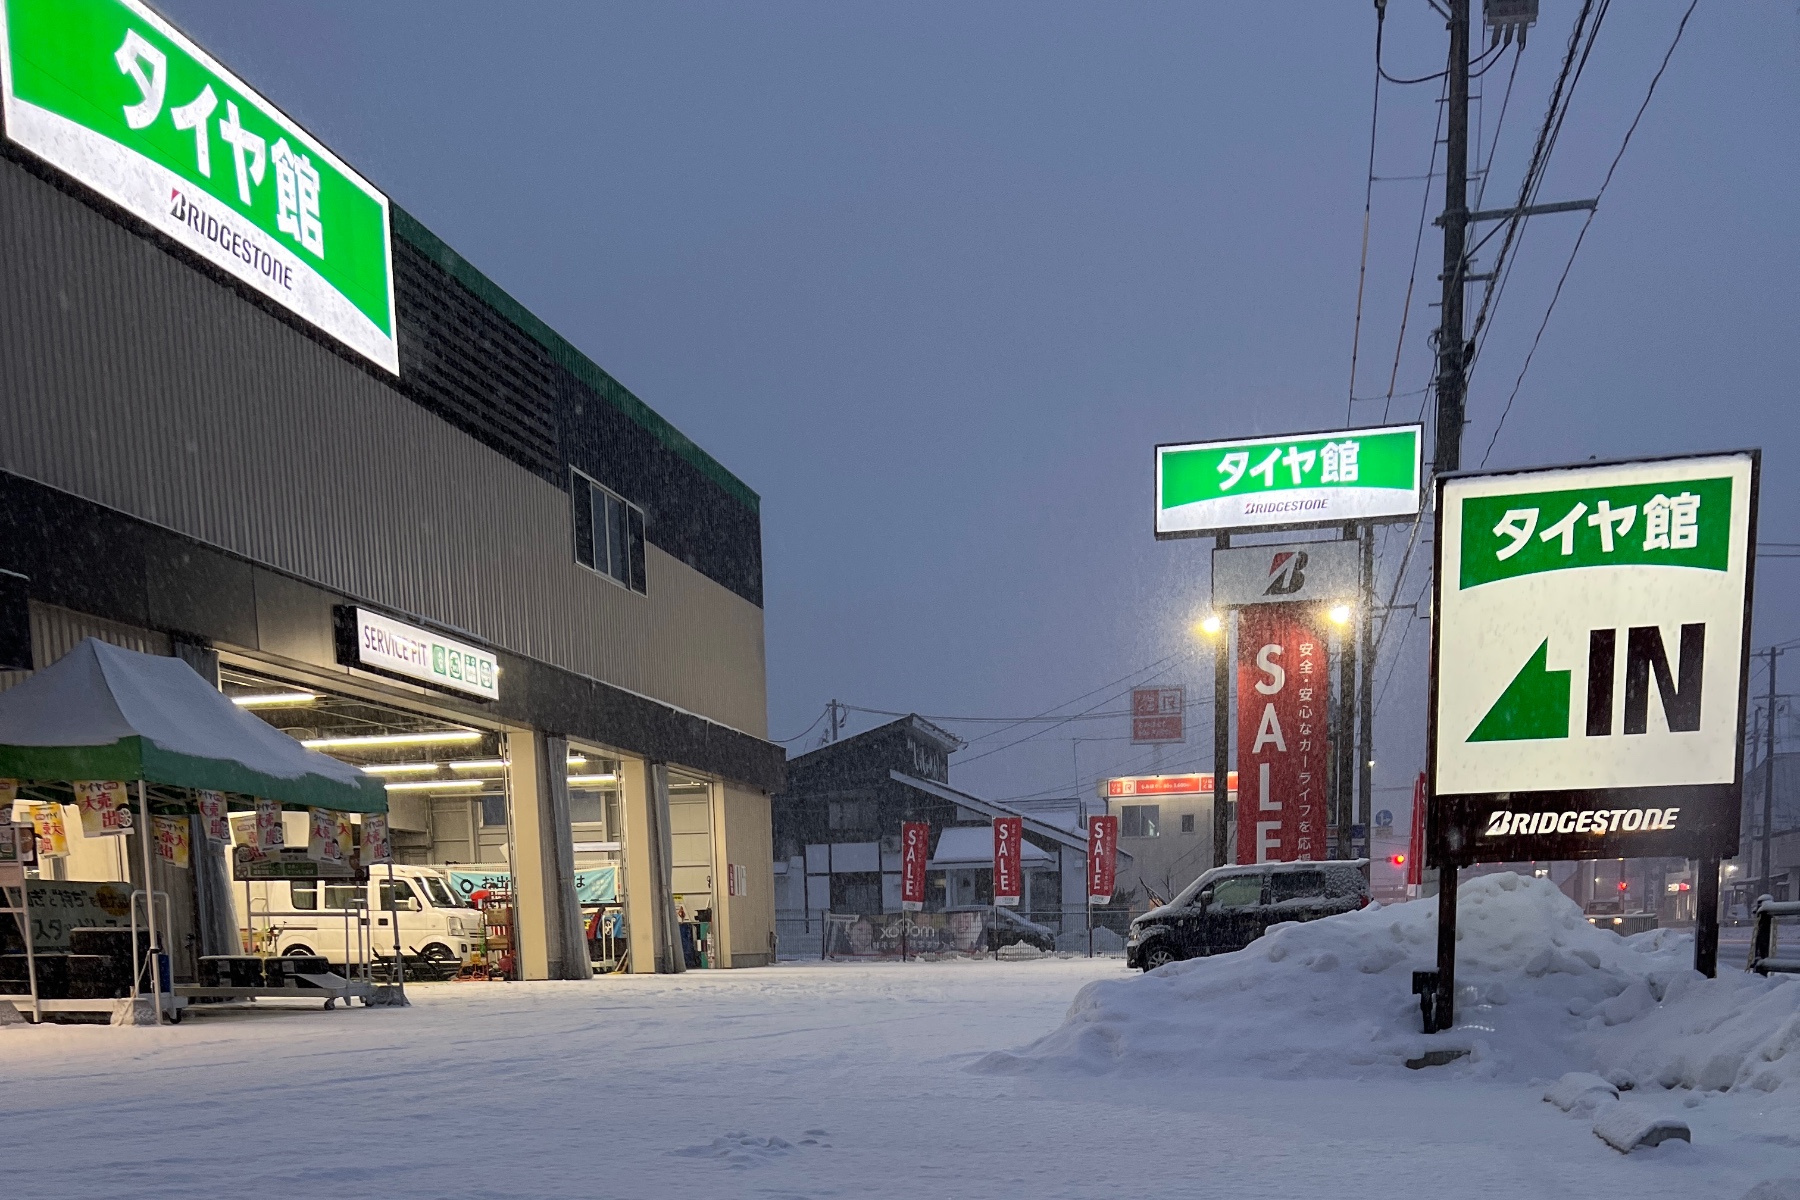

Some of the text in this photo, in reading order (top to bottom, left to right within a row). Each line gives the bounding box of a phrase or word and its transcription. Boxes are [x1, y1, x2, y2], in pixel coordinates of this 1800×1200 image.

[114, 28, 324, 260] タイヤ館
[170, 187, 293, 291] BRIDGESTONE
[1217, 440, 1360, 491] タイヤ館
[1245, 498, 1329, 515] BRIDGESTONE
[1493, 492, 1700, 561] タイヤ館
[1586, 622, 1706, 737] IN
[1252, 643, 1287, 863] SALE
[1094, 822, 1104, 889] SALE
[1485, 807, 1680, 836] BRIDGESTONE
[905, 829, 917, 896] SALE
[998, 823, 1008, 891] SALE
